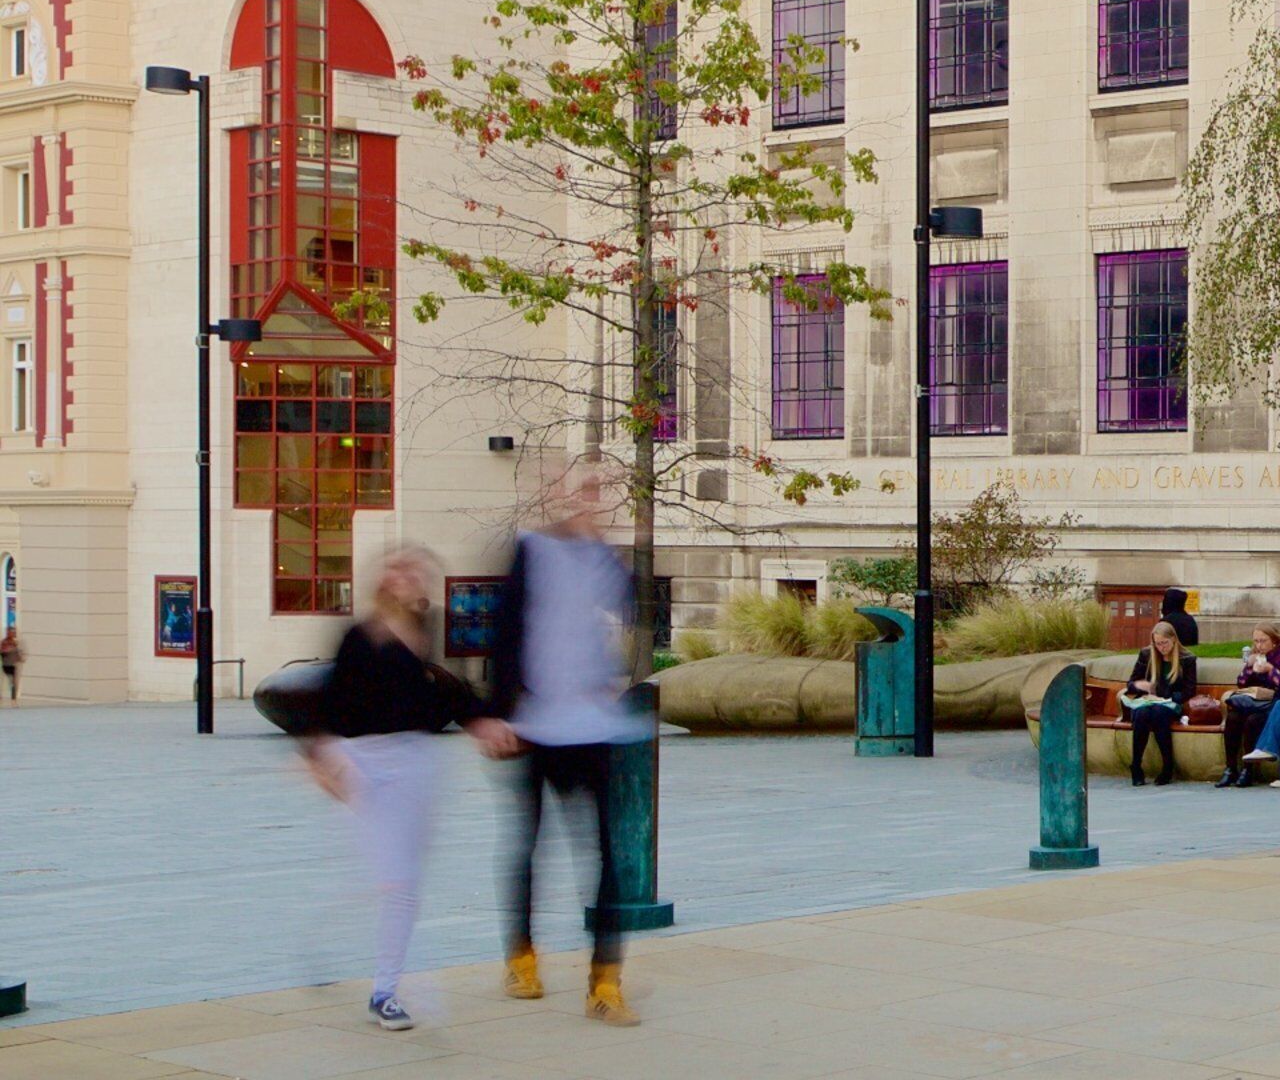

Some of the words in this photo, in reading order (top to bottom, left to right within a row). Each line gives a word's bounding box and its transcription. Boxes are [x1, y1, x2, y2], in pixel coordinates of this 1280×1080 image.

[879, 468, 975, 490] CENRAL
[1092, 467, 1141, 489] AND
[1153, 465, 1246, 489] GRAVES
